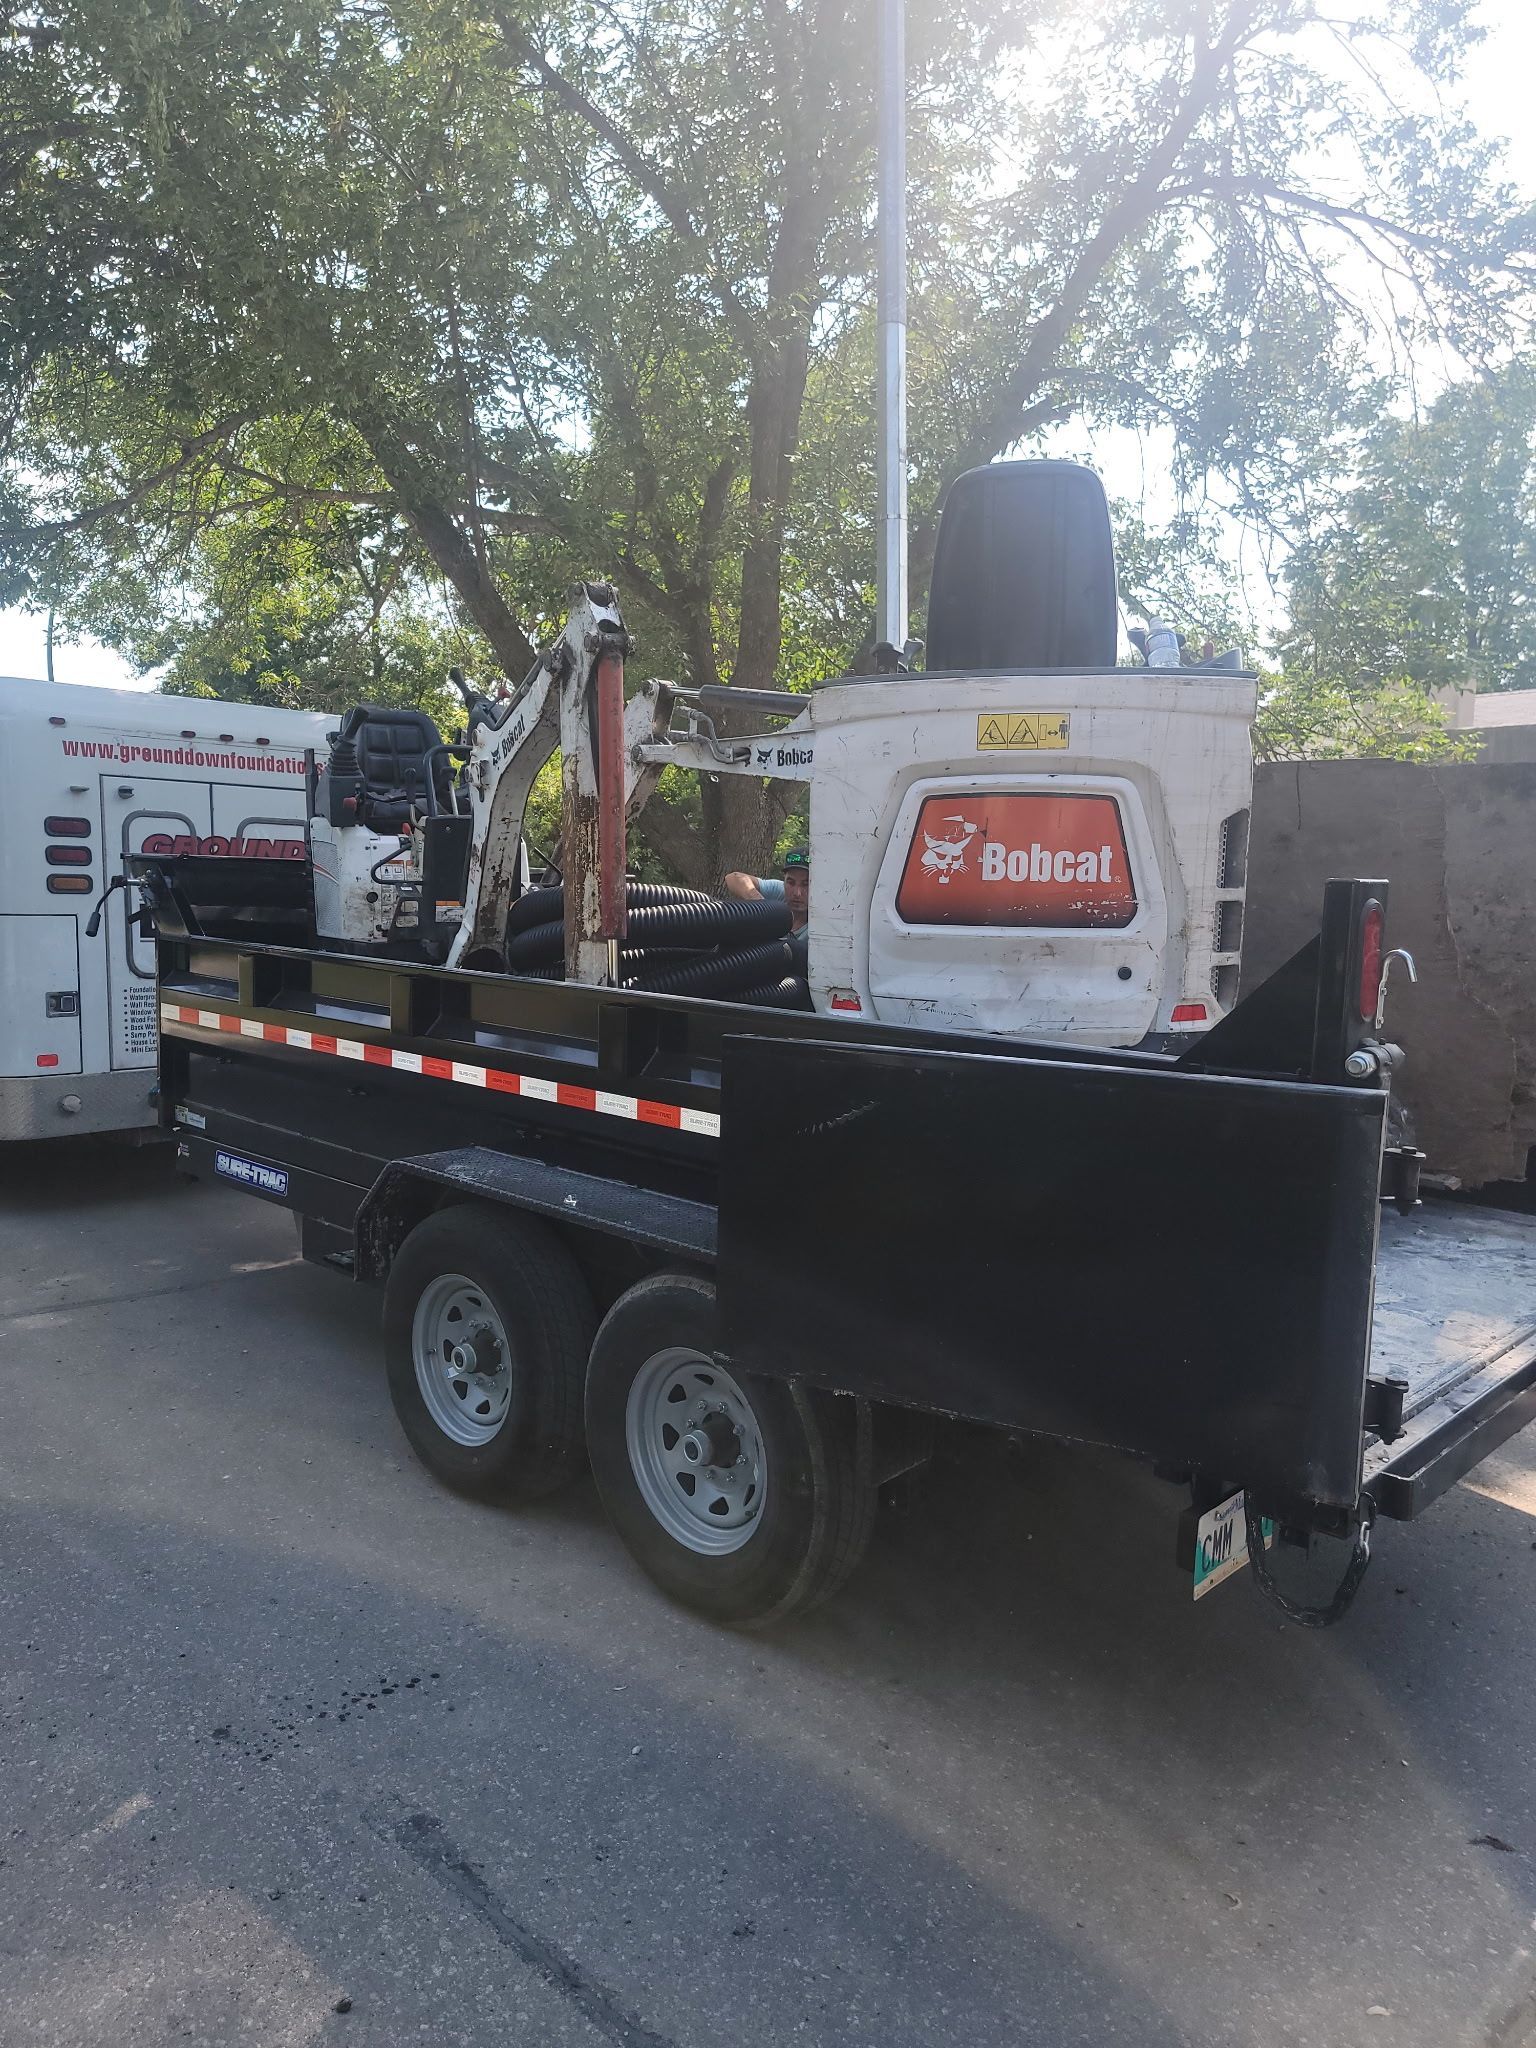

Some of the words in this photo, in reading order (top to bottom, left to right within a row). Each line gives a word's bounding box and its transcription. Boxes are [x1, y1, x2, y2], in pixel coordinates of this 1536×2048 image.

[62, 740, 324, 775] www.grounddownfoundatios
[777, 749, 813, 767] Bobca
[141, 833, 305, 859] GROUND
[982, 842, 1112, 883] Bobcat
[217, 1154, 286, 1192] SURE-TRAC
[1202, 1518, 1234, 1572] CMM
